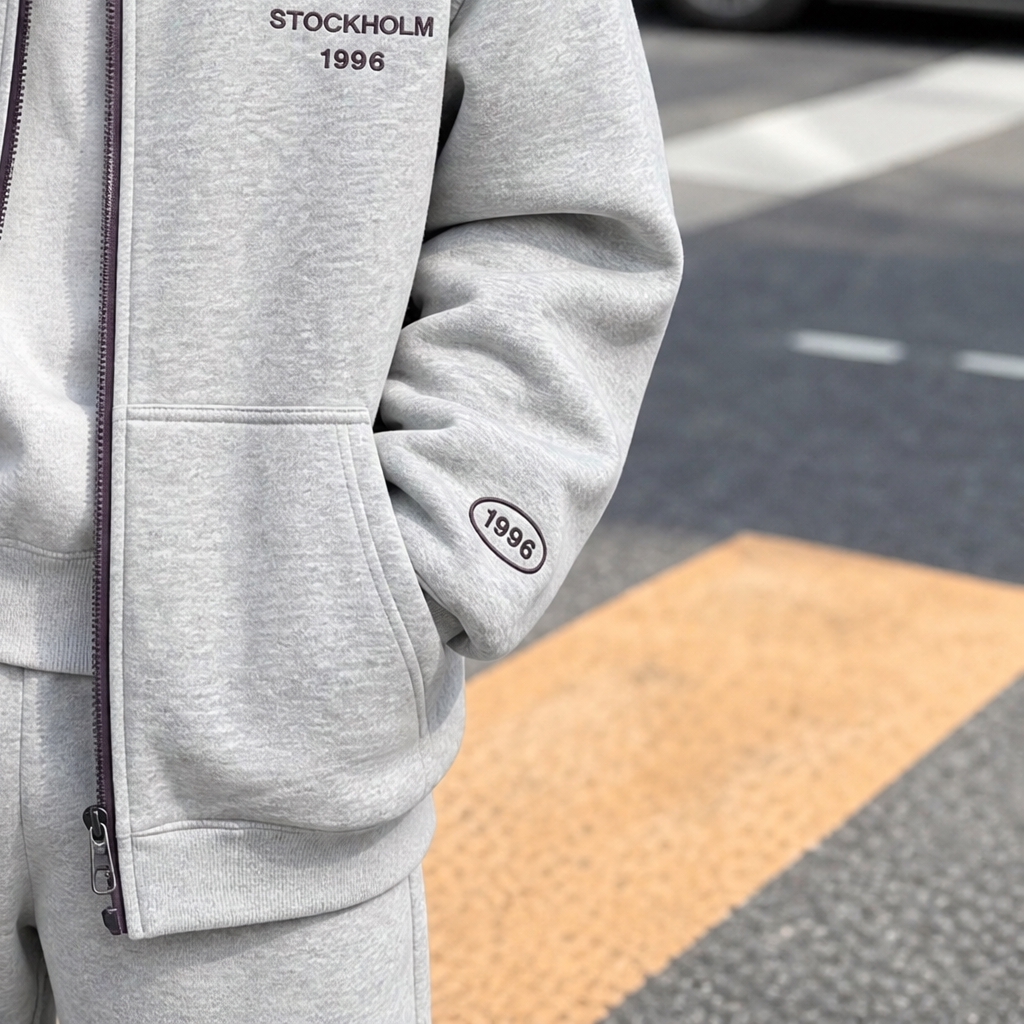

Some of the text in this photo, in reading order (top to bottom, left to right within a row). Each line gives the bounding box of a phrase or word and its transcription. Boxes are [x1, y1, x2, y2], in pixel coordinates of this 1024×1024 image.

[269, 8, 435, 38] STOCKHOLM
[320, 48, 385, 72] 1996
[484, 508, 536, 560] 1996
